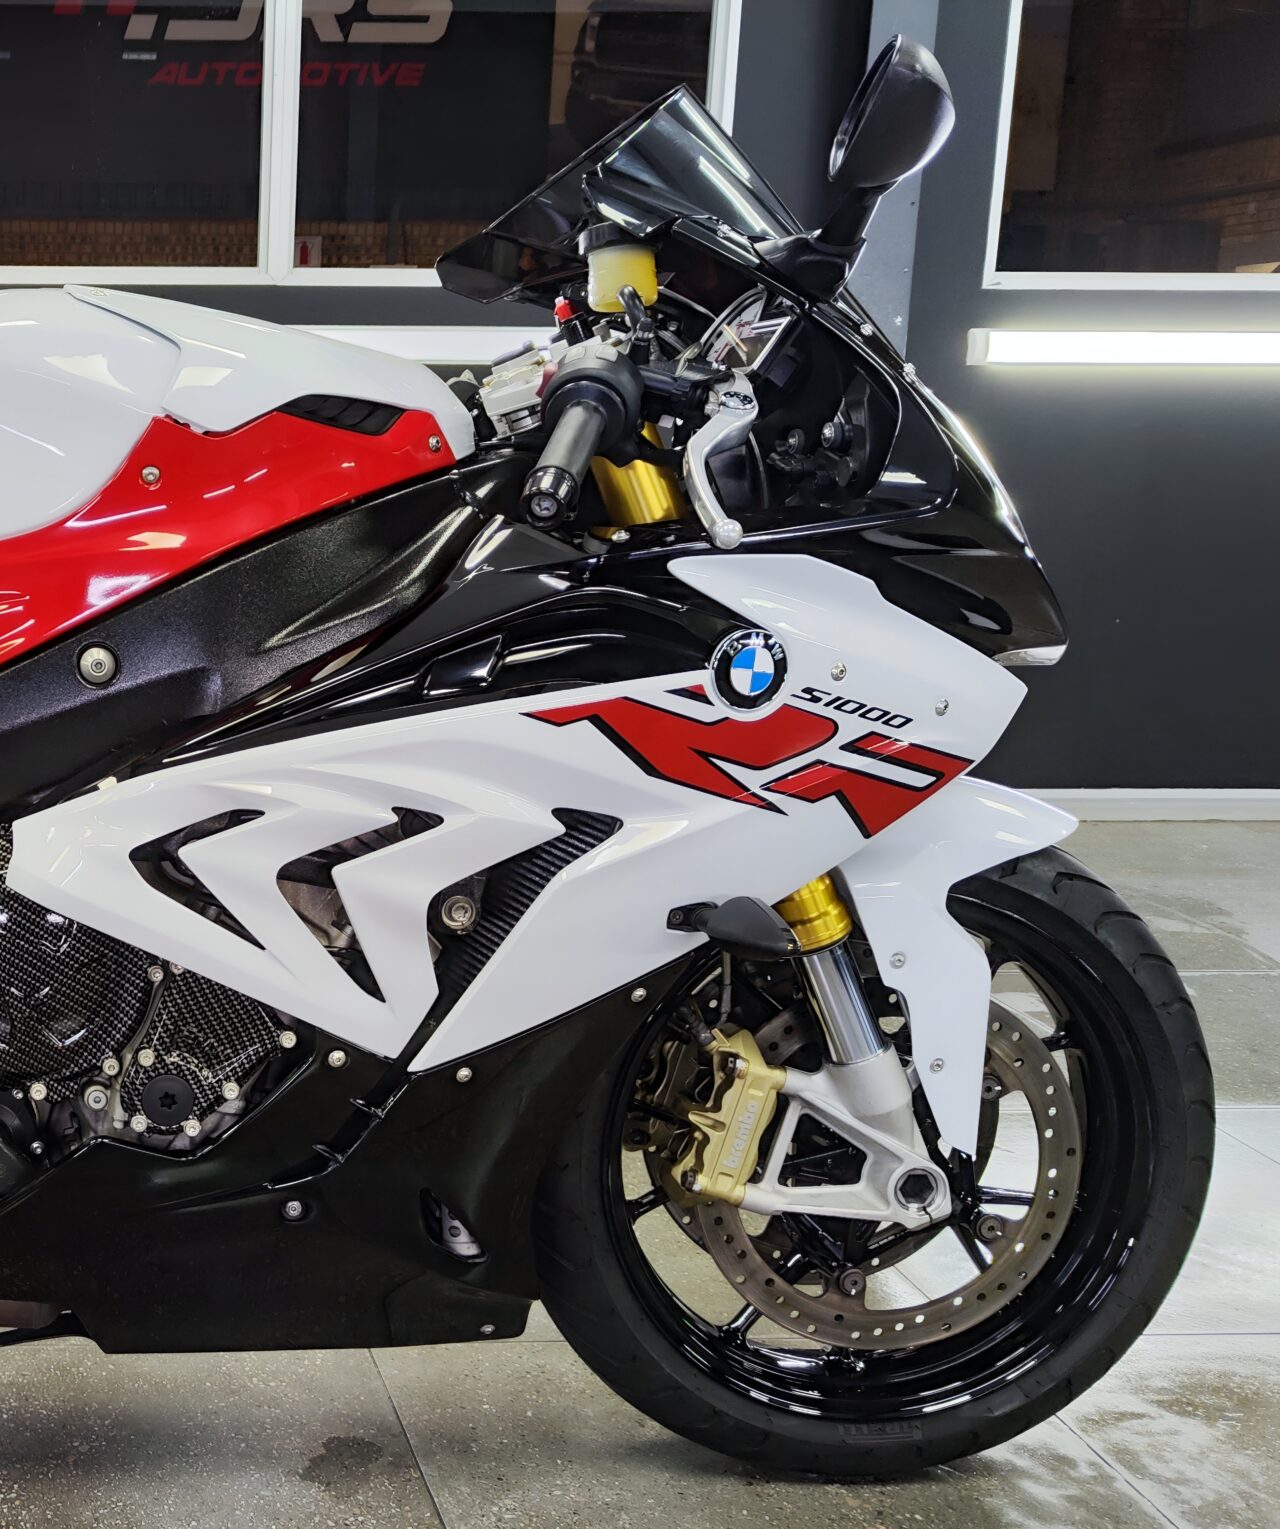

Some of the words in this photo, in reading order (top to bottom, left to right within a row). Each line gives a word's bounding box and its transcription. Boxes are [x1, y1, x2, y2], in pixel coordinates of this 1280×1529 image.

[148, 61, 425, 87] AUTOOTIVE
[726, 632, 784, 661] BMW
[790, 686, 914, 729] S1000
[723, 1100, 758, 1169] brembo
